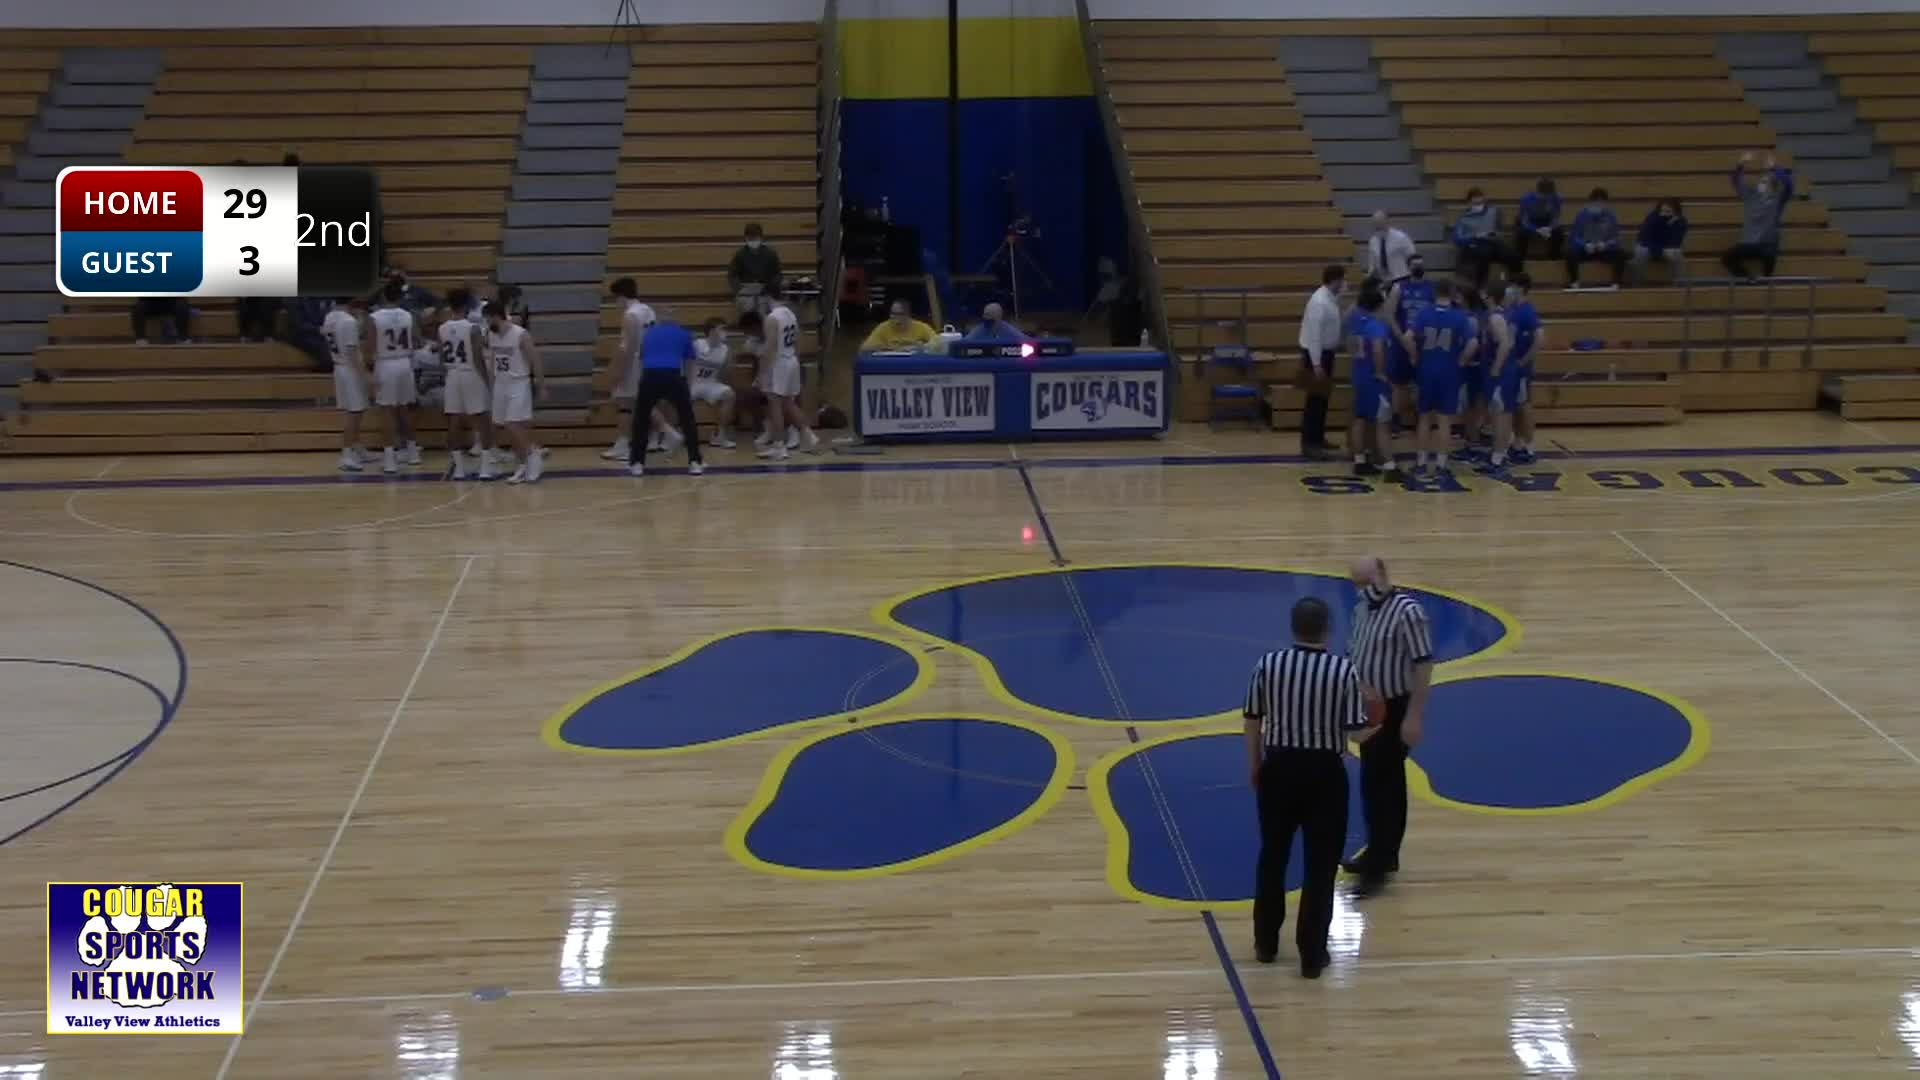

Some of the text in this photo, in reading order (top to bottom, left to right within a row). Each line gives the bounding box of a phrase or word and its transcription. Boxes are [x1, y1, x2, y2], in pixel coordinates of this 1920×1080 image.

[866, 384, 991, 420] VALLEY VIEW
[1036, 379, 1158, 423] COUGARS
